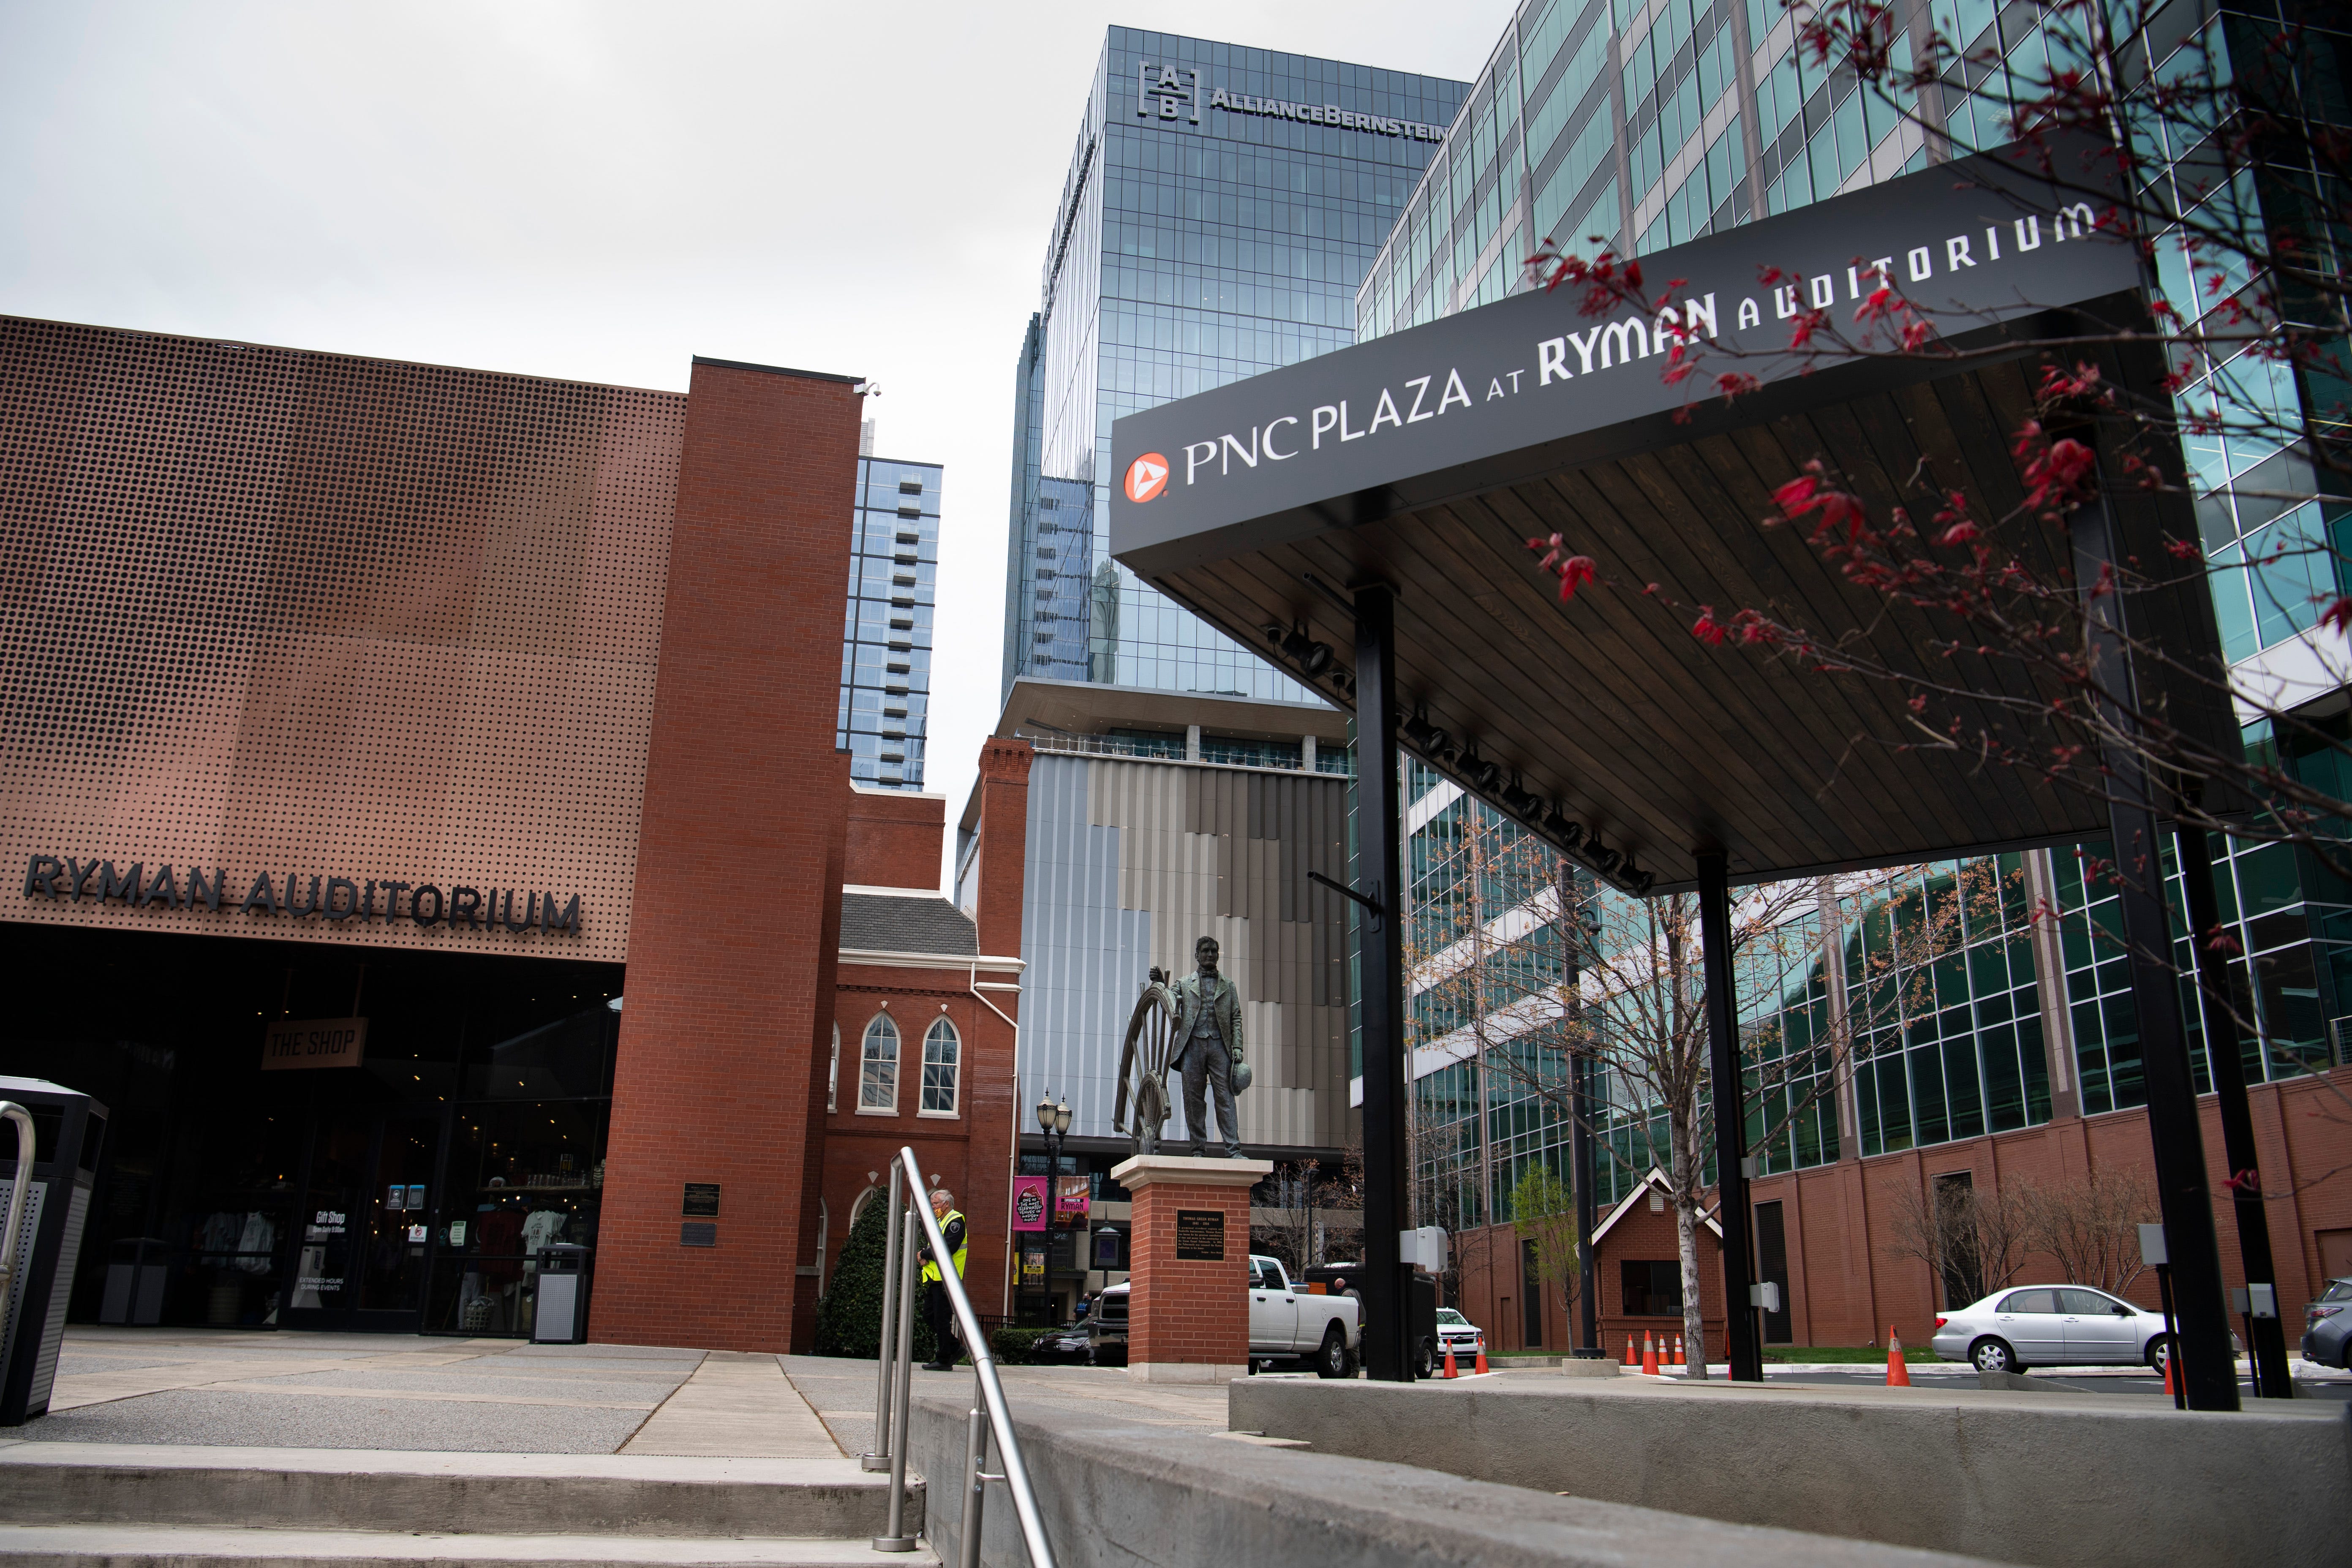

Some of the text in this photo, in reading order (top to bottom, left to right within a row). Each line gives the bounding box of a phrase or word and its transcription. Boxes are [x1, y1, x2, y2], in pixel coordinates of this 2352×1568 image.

[1182, 416, 1298, 485] PNC
[1312, 368, 1472, 450] PLAZA
[1486, 370, 1524, 401] AT
[1538, 292, 1718, 386] RYMAN
[23, 855, 580, 935] RYMAN AUDITORIUM
[272, 1030, 355, 1057] THE SHOP
[316, 1211, 346, 1225] Gift Shop
